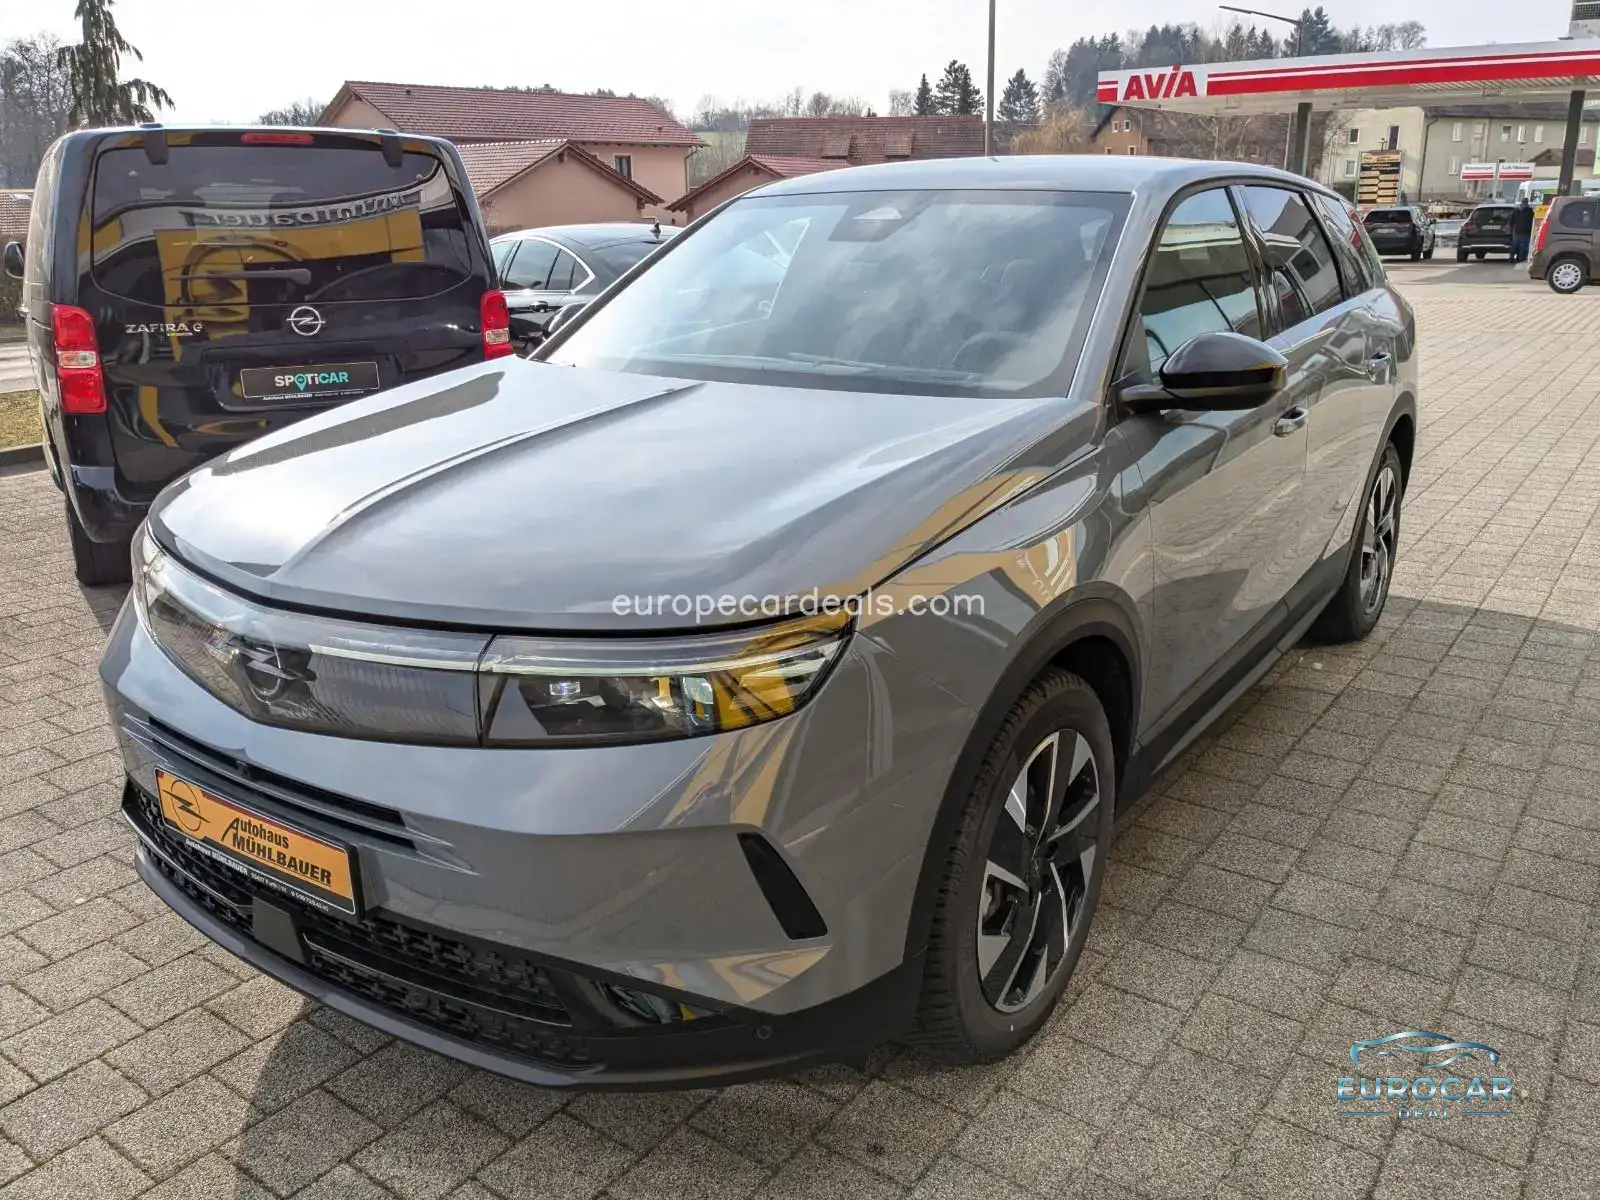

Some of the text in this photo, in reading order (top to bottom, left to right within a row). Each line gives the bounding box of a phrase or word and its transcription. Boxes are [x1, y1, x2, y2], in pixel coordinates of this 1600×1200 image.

[1122, 65, 1198, 101] AVIA
[125, 323, 190, 334] ZAFIRA
[221, 817, 290, 850] Autohaus
[185, 837, 248, 876] Autohaus MÜHLBAUER
[232, 832, 332, 885] MÜHLBAUER
